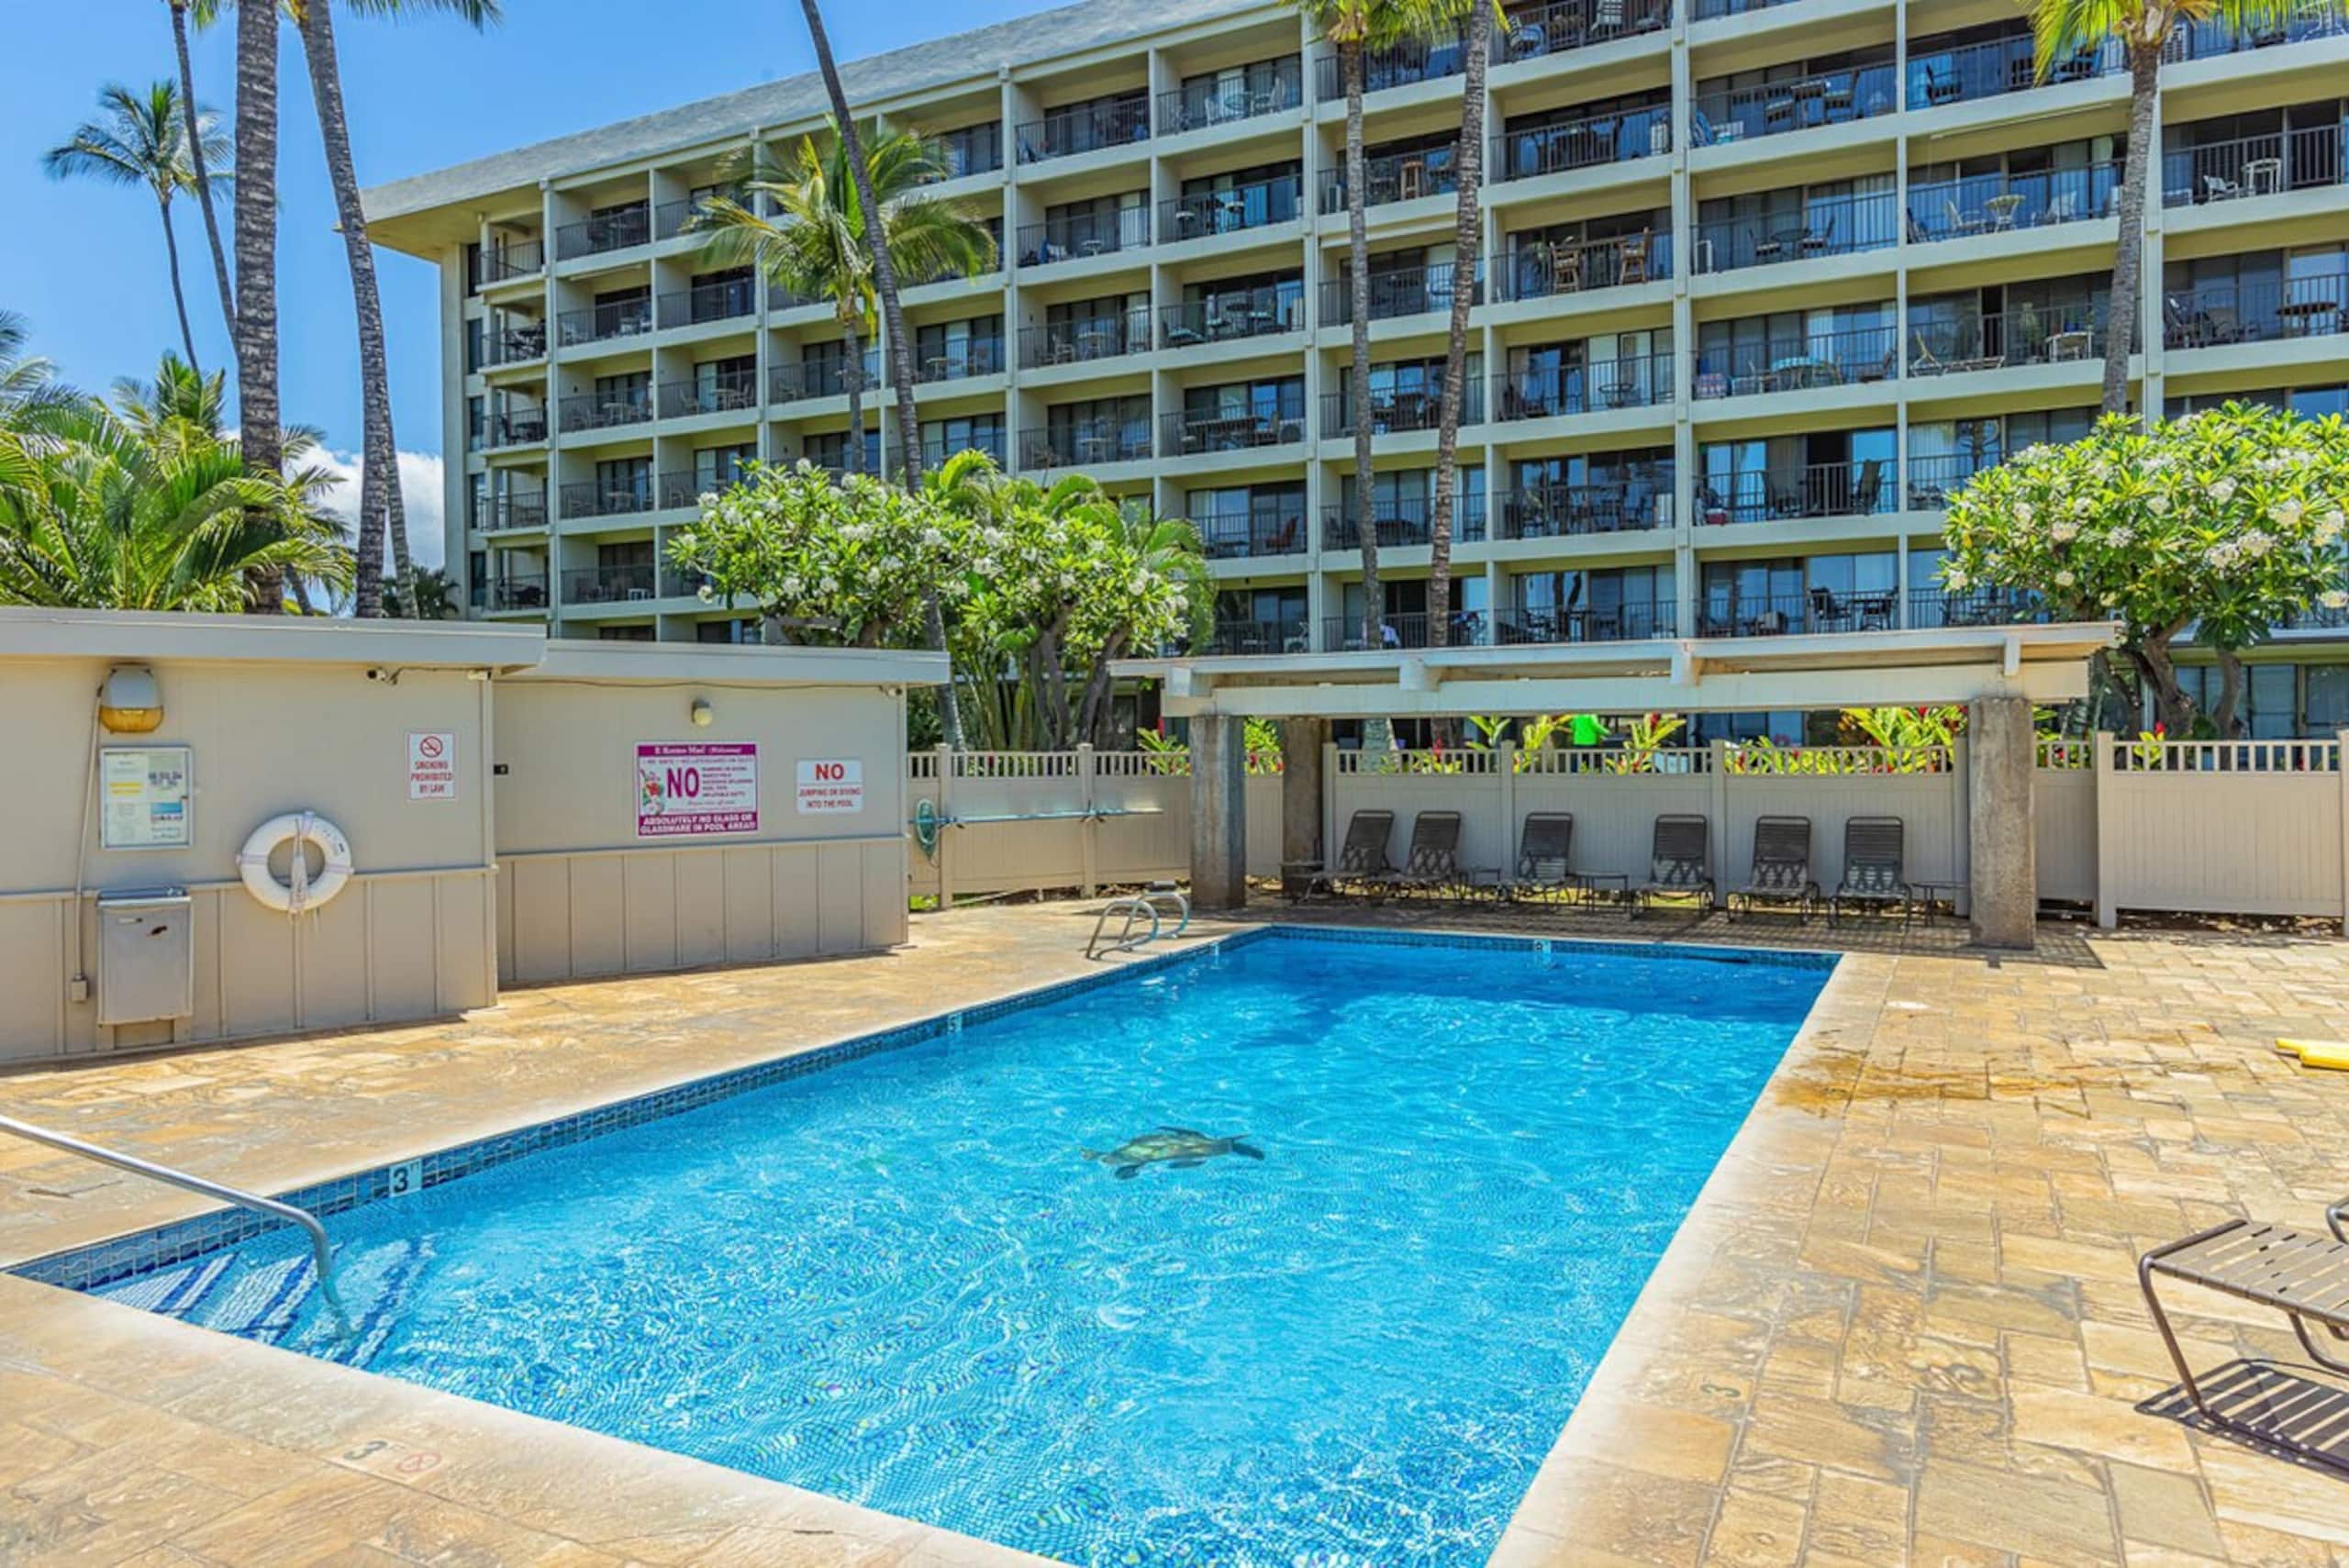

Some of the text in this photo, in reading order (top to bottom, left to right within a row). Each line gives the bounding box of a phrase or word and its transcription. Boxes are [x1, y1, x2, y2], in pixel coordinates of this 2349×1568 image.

[815, 762, 844, 781] NO
[666, 767, 699, 798] NO
[640, 825, 692, 834] GLASSWARE
[693, 824, 703, 832] IN
[704, 823, 725, 832] POOL
[643, 813, 752, 825] ABSOLUTELY NO GLASS OR
[394, 1165, 408, 1193] 3
